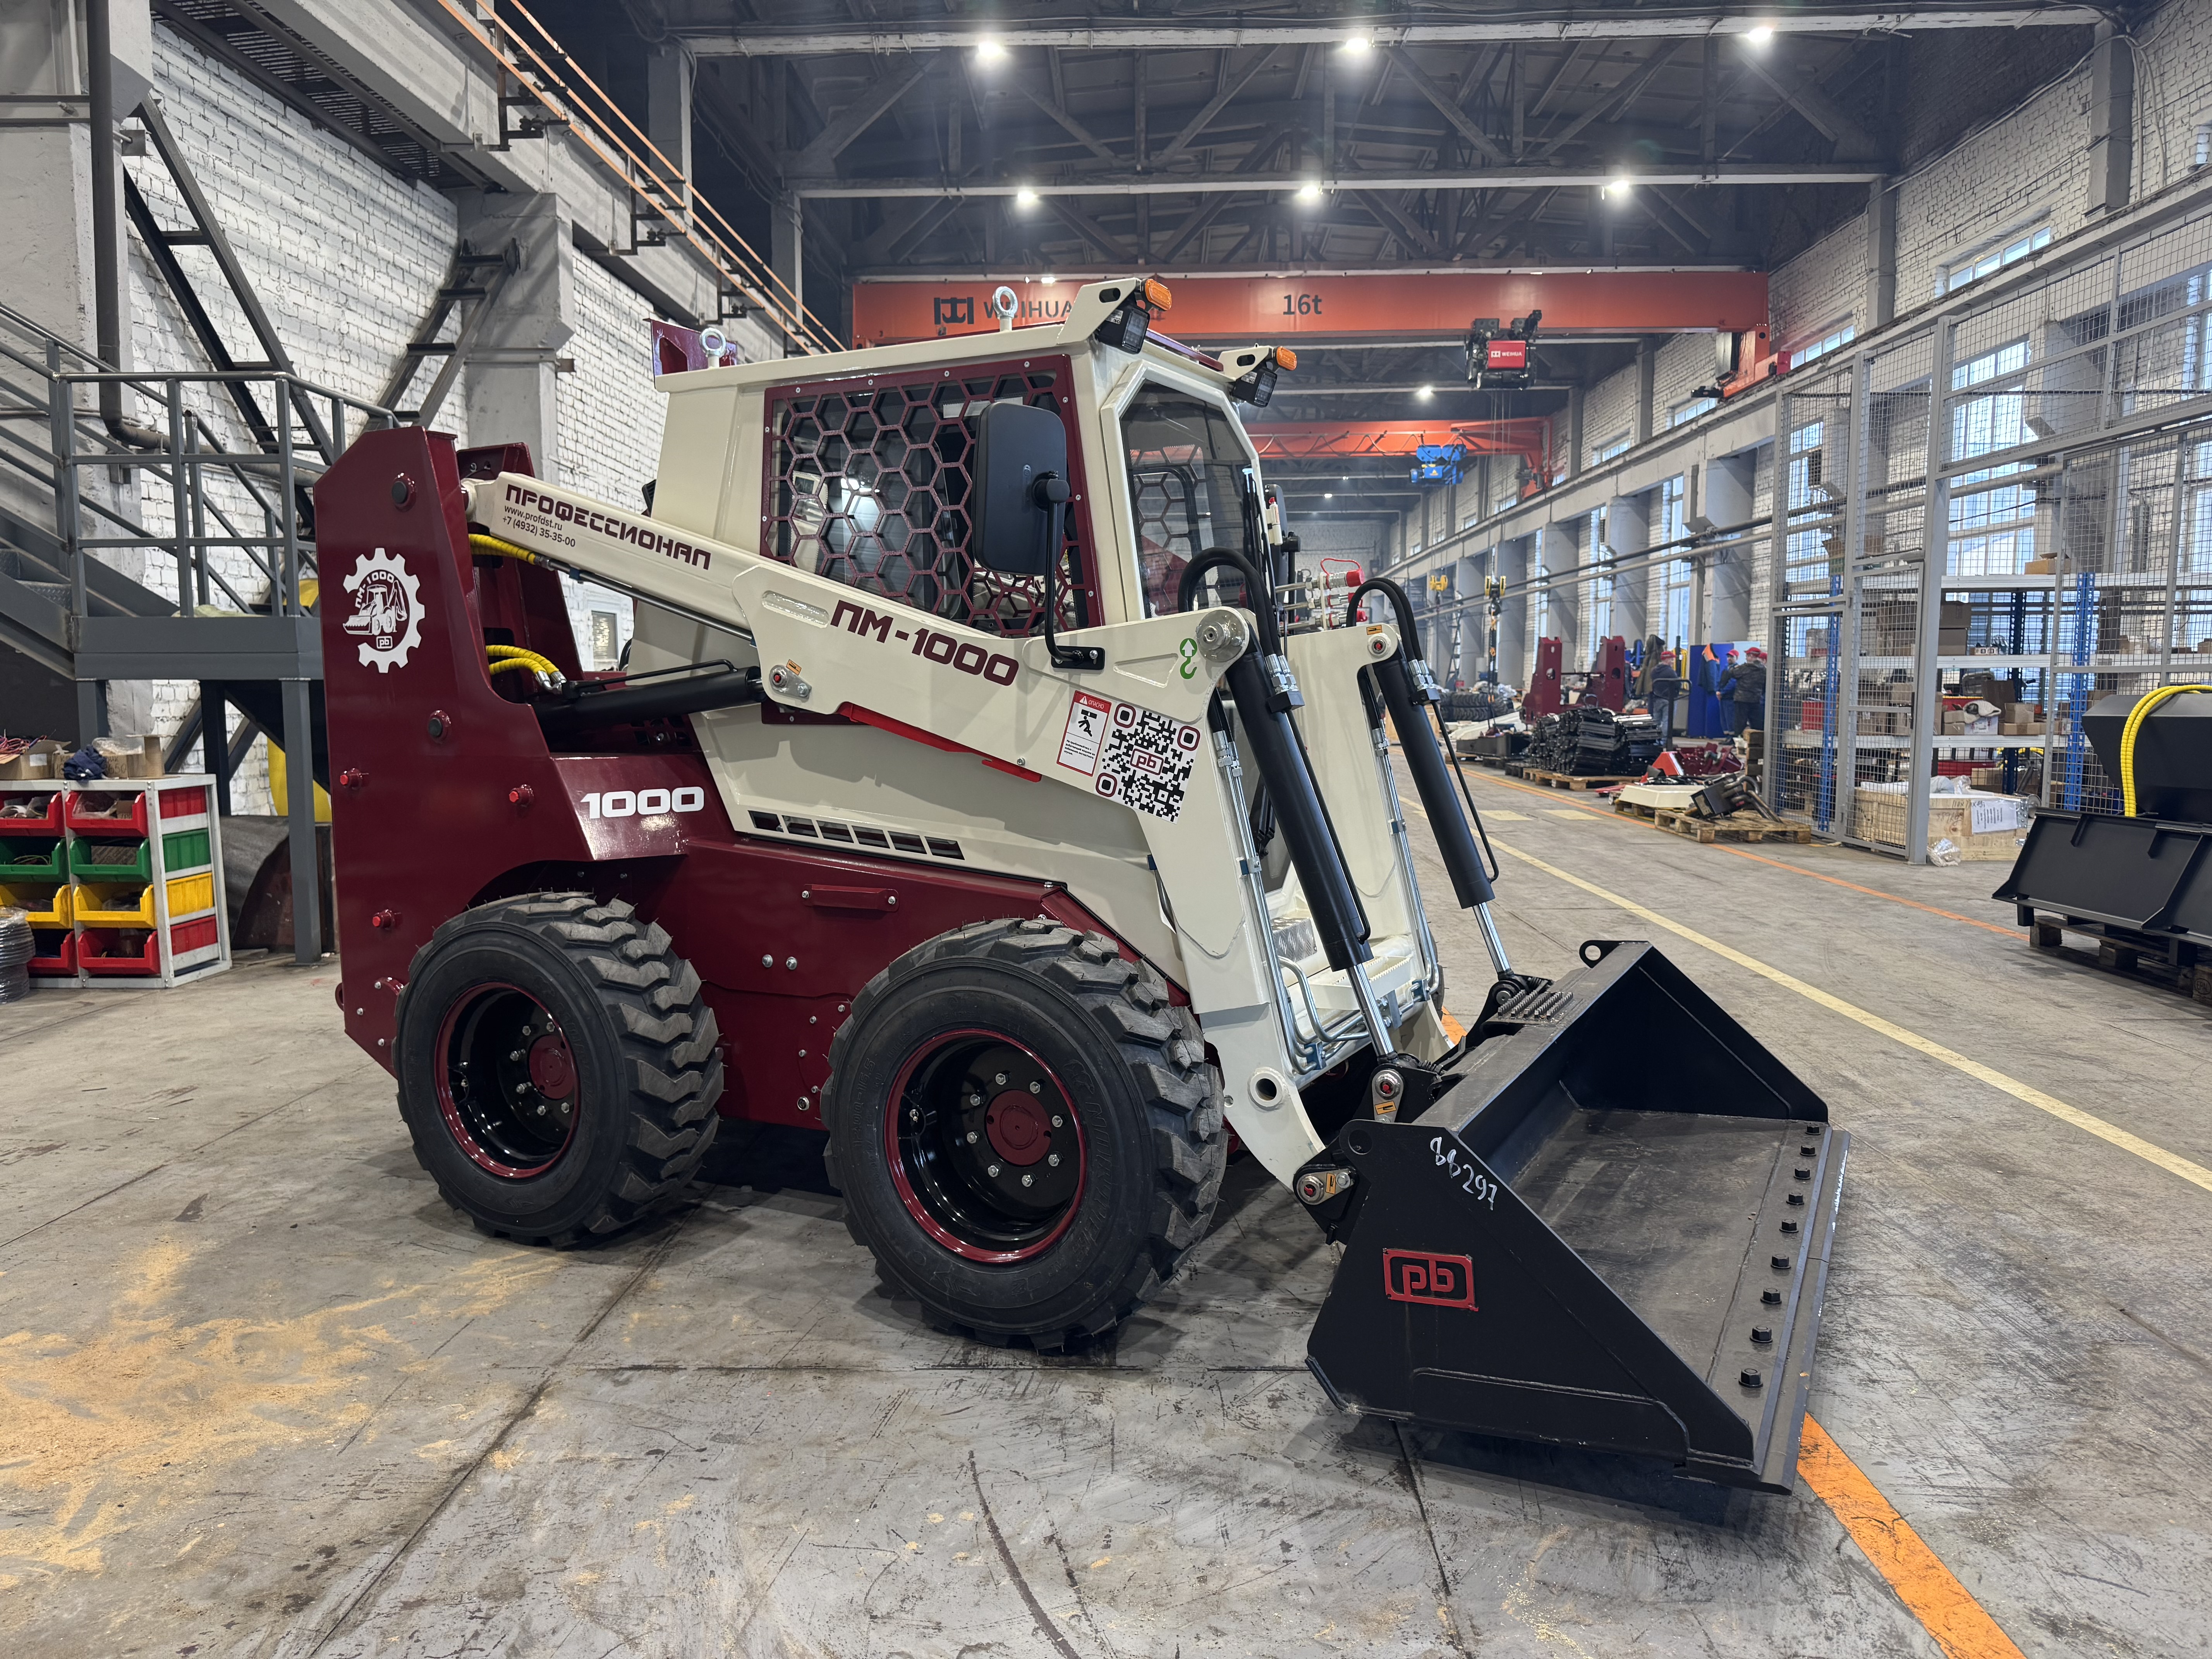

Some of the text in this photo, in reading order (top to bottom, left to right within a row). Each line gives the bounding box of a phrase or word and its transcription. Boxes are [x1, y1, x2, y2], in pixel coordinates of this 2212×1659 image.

[1283, 294, 1322, 315] 16t
[503, 516, 576, 547] +7 (4932) 35-35-00
[504, 505, 563, 531] www.profdst.ru
[355, 571, 395, 608] ПМ-1000
[830, 599, 1019, 686] ПМ-1000
[1088, 700, 1104, 709] ОПАСНО
[580, 787, 704, 819] 1000
